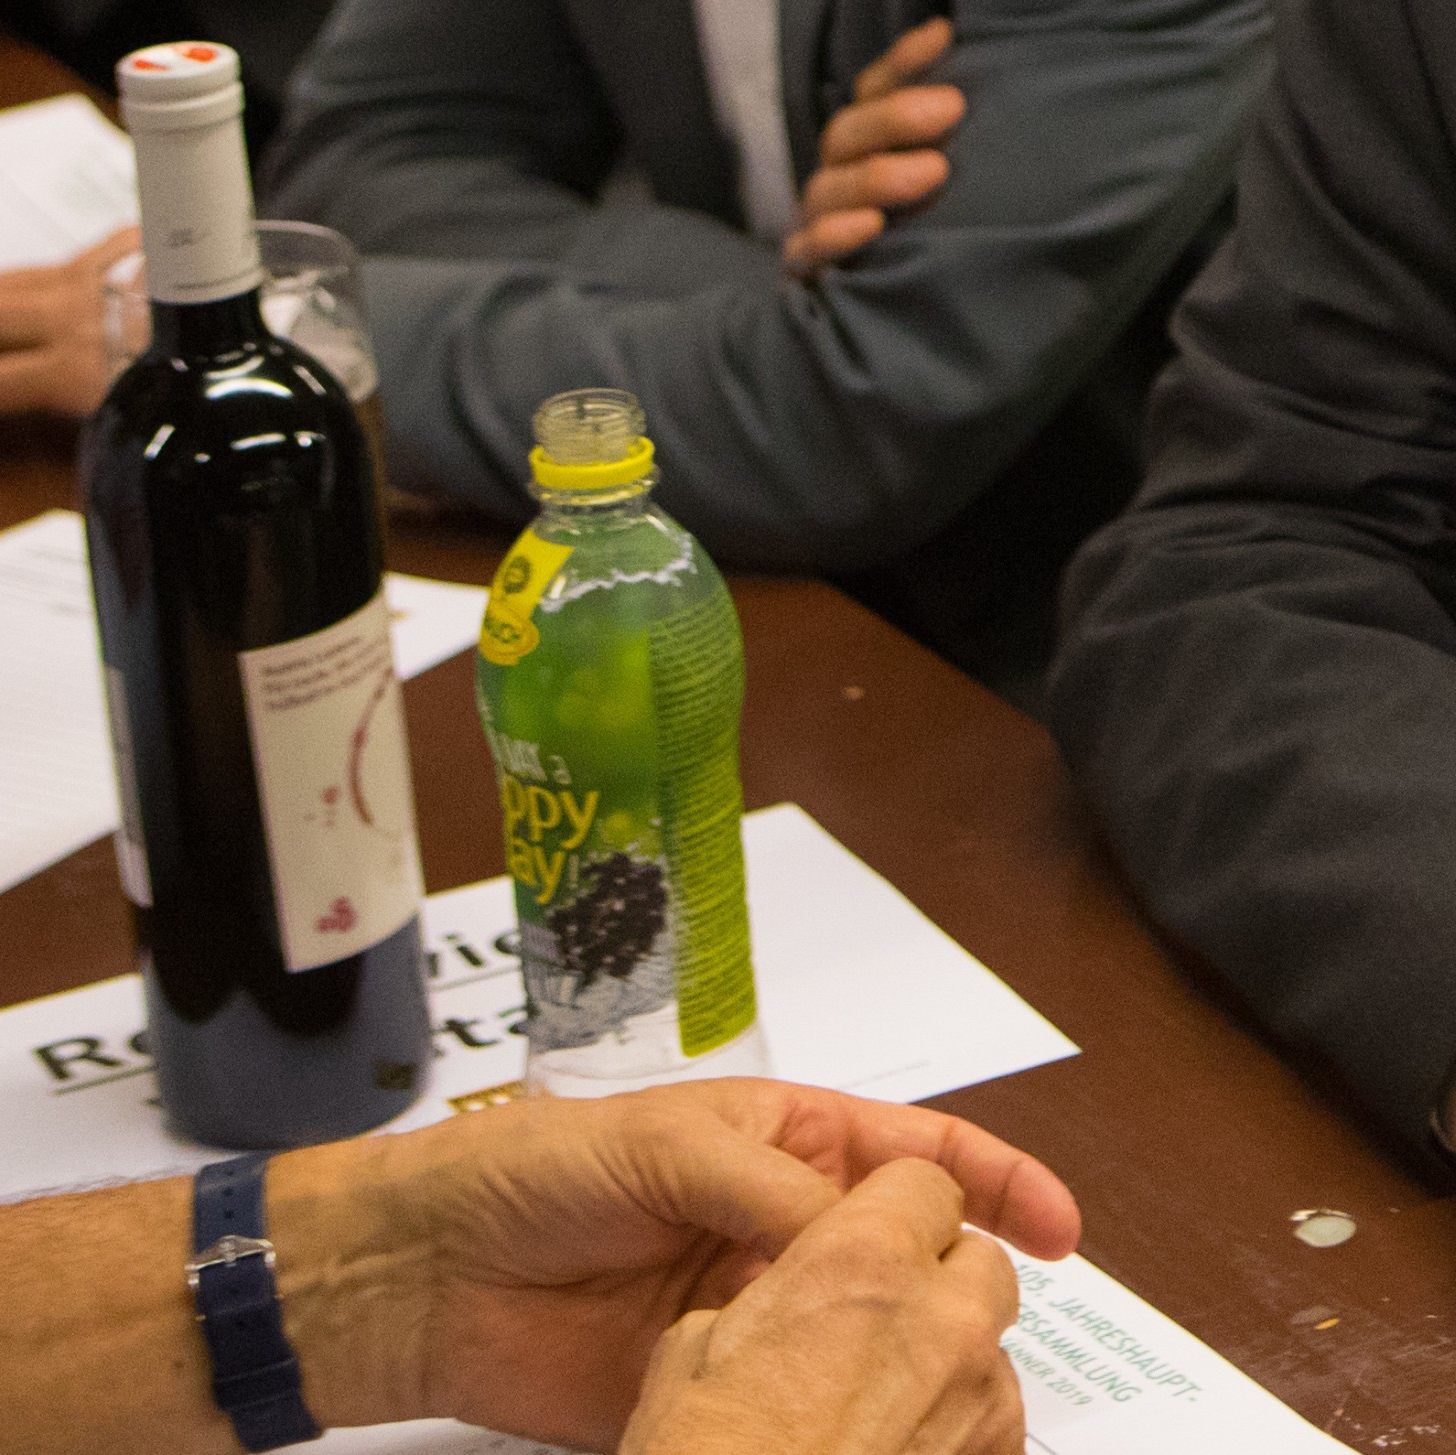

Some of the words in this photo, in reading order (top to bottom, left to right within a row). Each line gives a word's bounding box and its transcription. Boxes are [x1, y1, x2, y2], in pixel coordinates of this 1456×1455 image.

[503, 774, 600, 850] ppy
[1048, 1296, 1204, 1402] JAHRESHAUPT-
[1046, 1376, 1095, 1407] 2019
